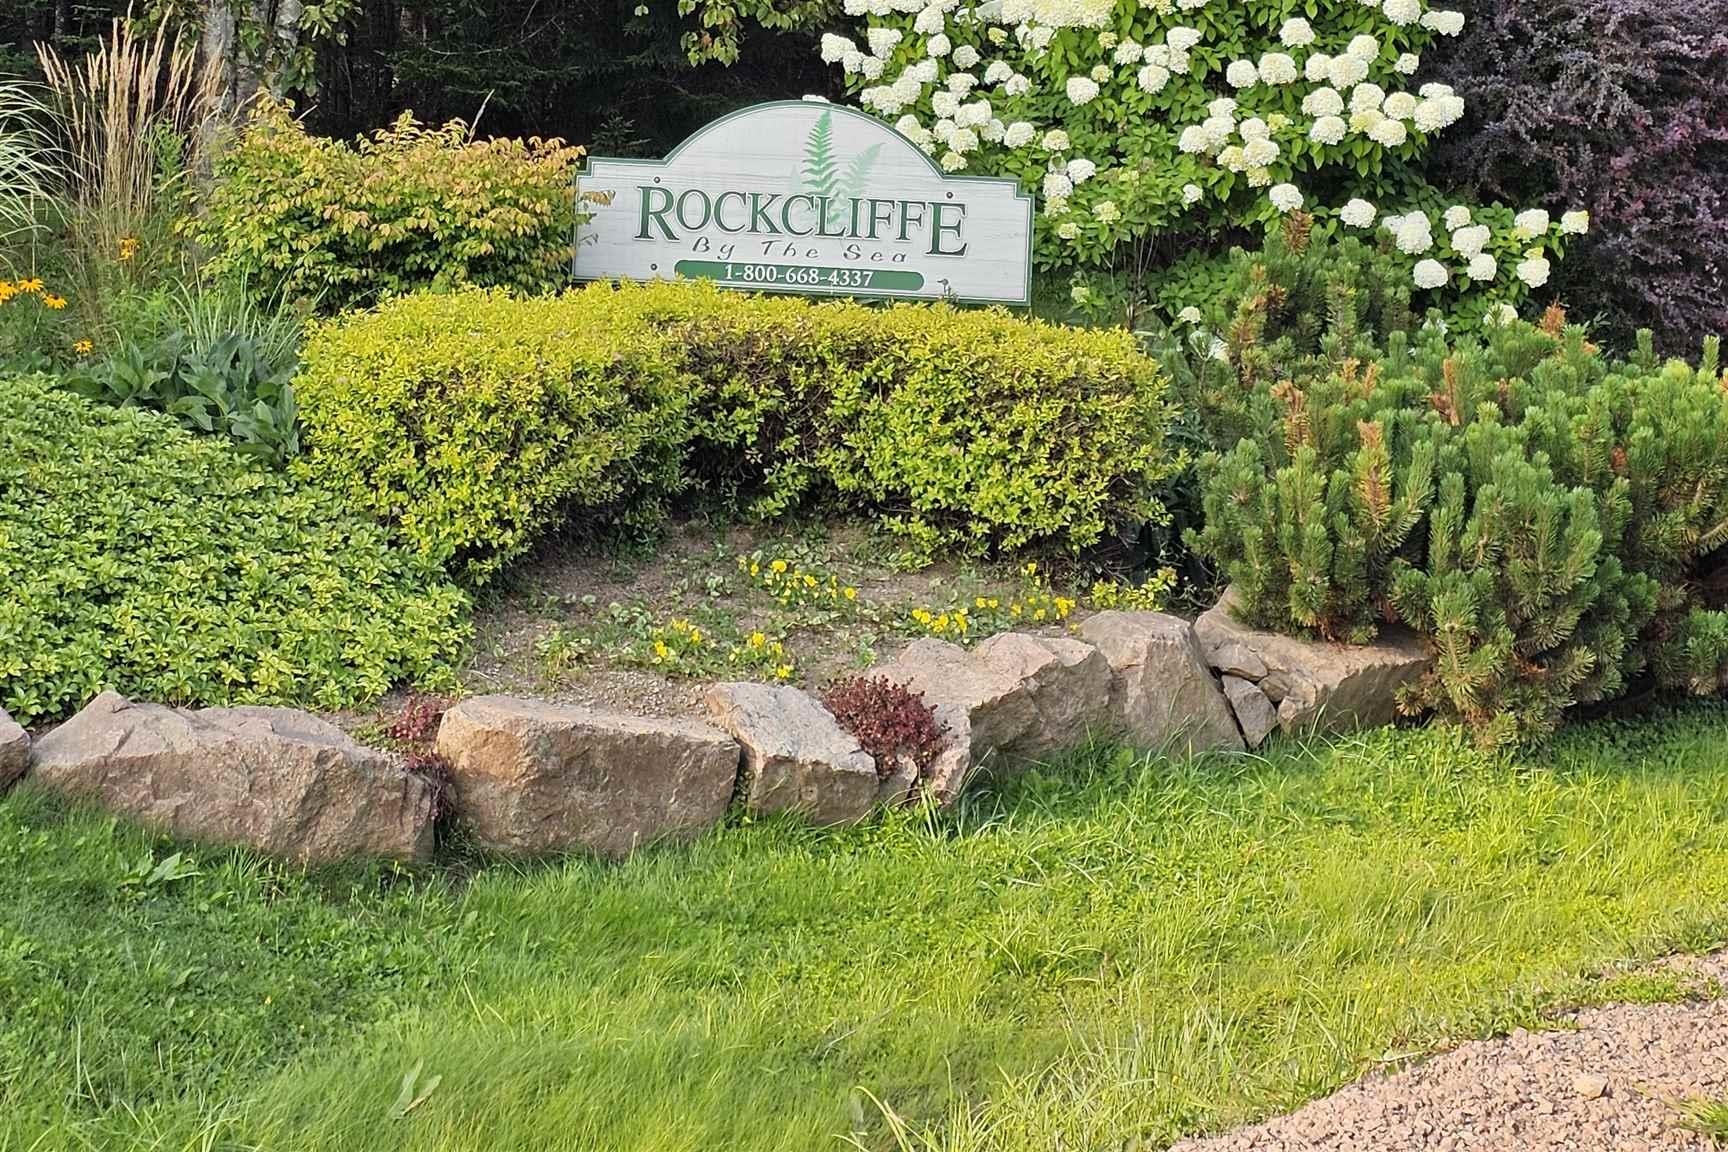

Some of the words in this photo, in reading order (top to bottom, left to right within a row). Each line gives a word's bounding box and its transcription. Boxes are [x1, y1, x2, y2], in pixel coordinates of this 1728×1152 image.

[634, 185, 968, 257] ROCKCLIFFE
[692, 236, 736, 261] By
[760, 239, 819, 259] The
[842, 243, 908, 263] Sea
[724, 264, 874, 287] 1-800-668-4337
